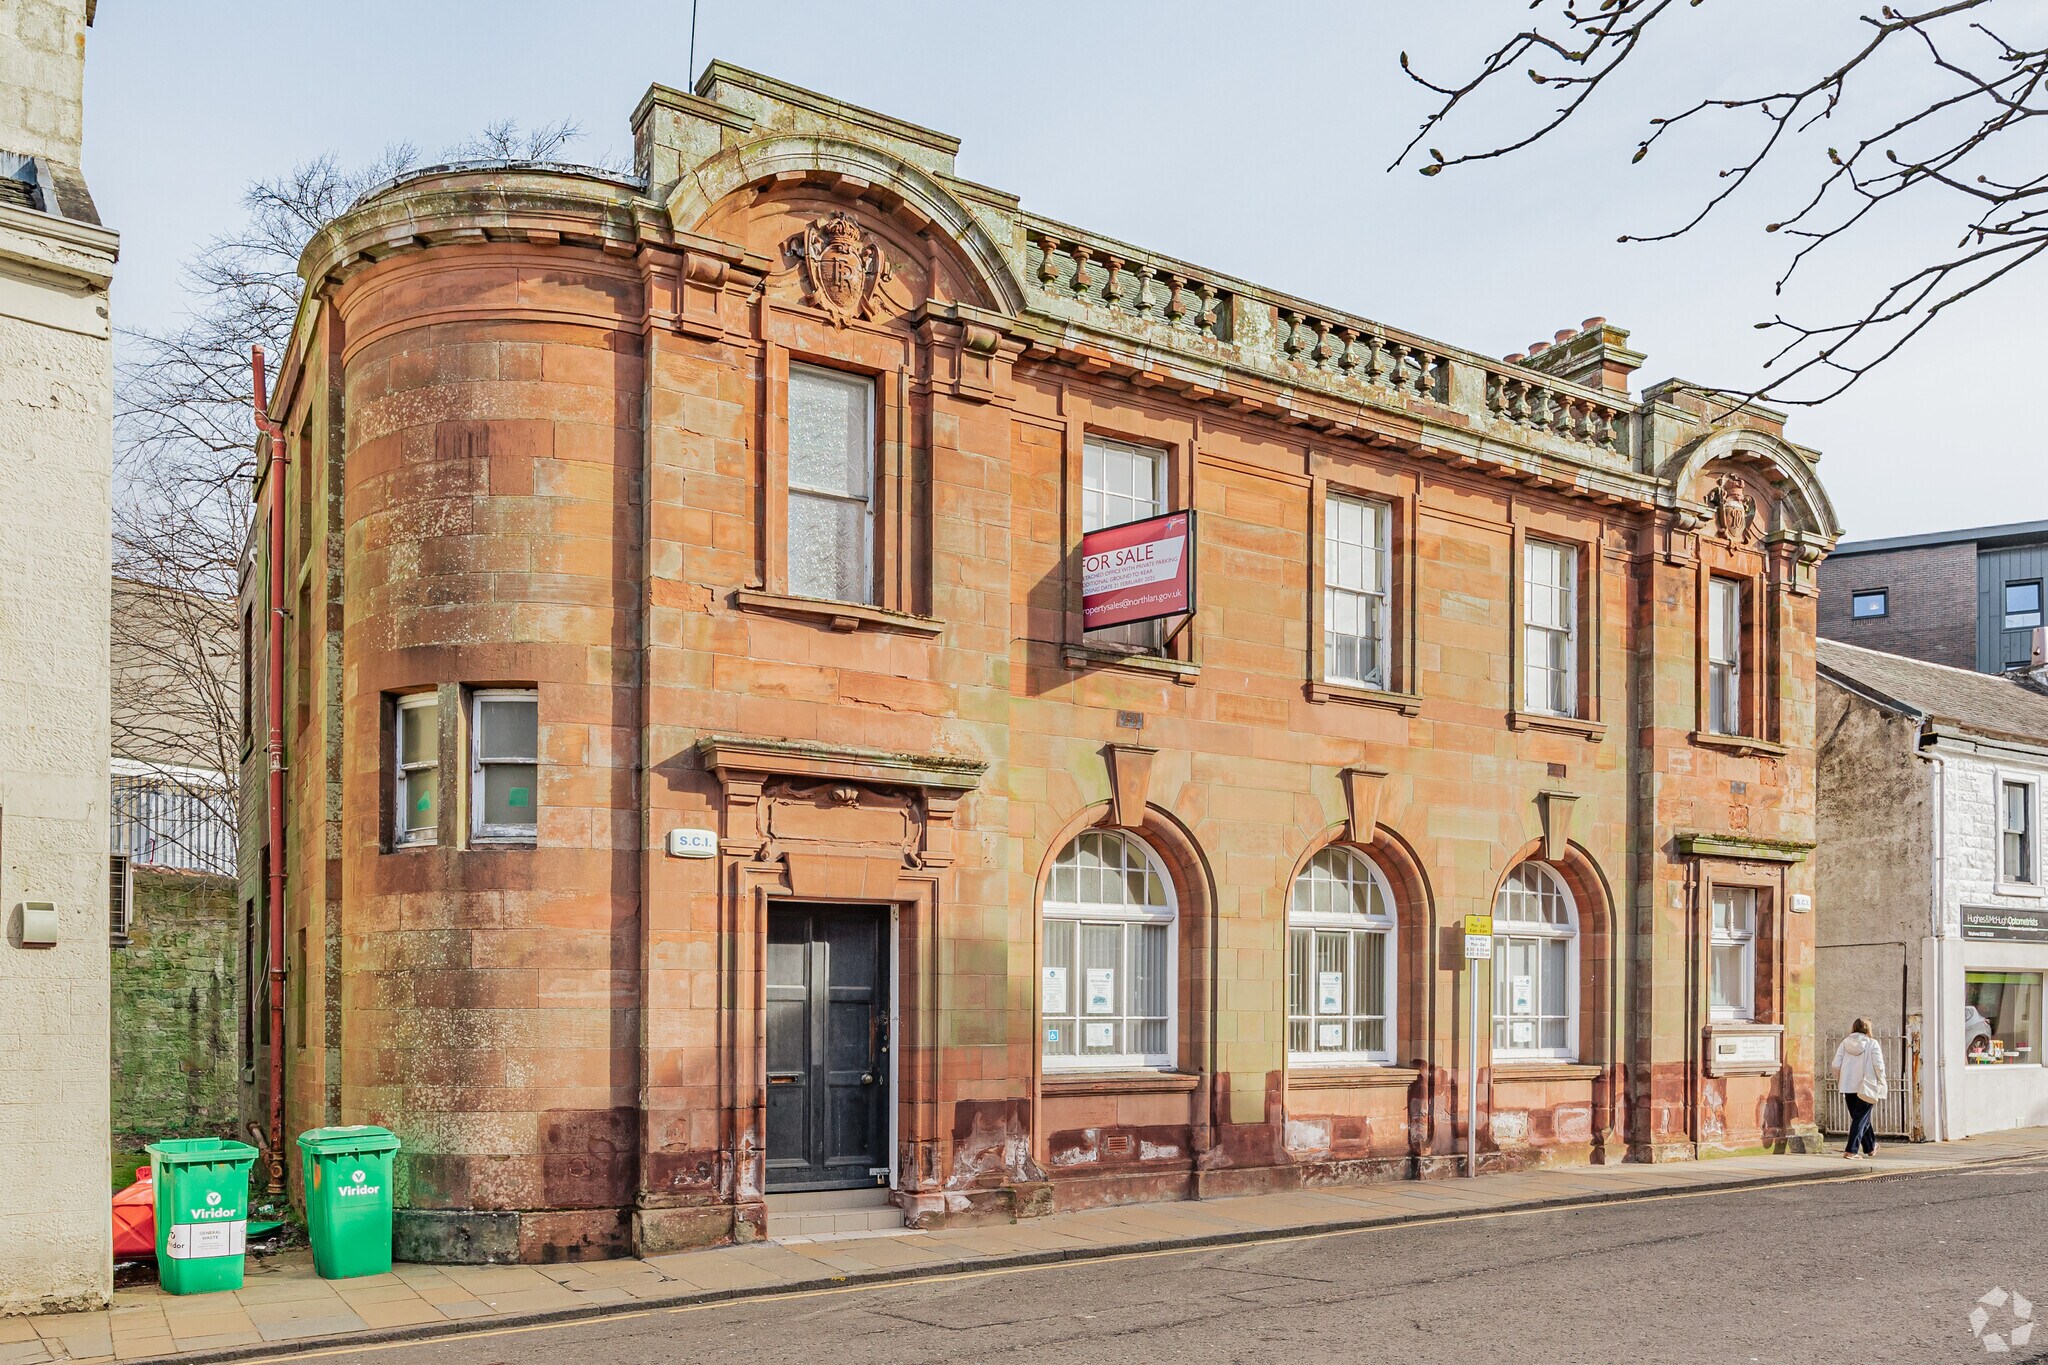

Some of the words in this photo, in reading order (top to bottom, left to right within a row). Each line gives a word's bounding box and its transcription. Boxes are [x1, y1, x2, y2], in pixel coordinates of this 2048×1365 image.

[1116, 544, 1154, 566] SALE
[1104, 568, 1121, 577] OFFICE
[1136, 561, 1155, 570] PRIVATE
[1156, 556, 1178, 566] PARKING
[1110, 573, 1132, 582] GROUND
[1120, 578, 1144, 587] FEBRUARY
[680, 836, 712, 846] S.C.I.
[338, 1184, 380, 1196] Viridor
[190, 1208, 236, 1220] Viridor
